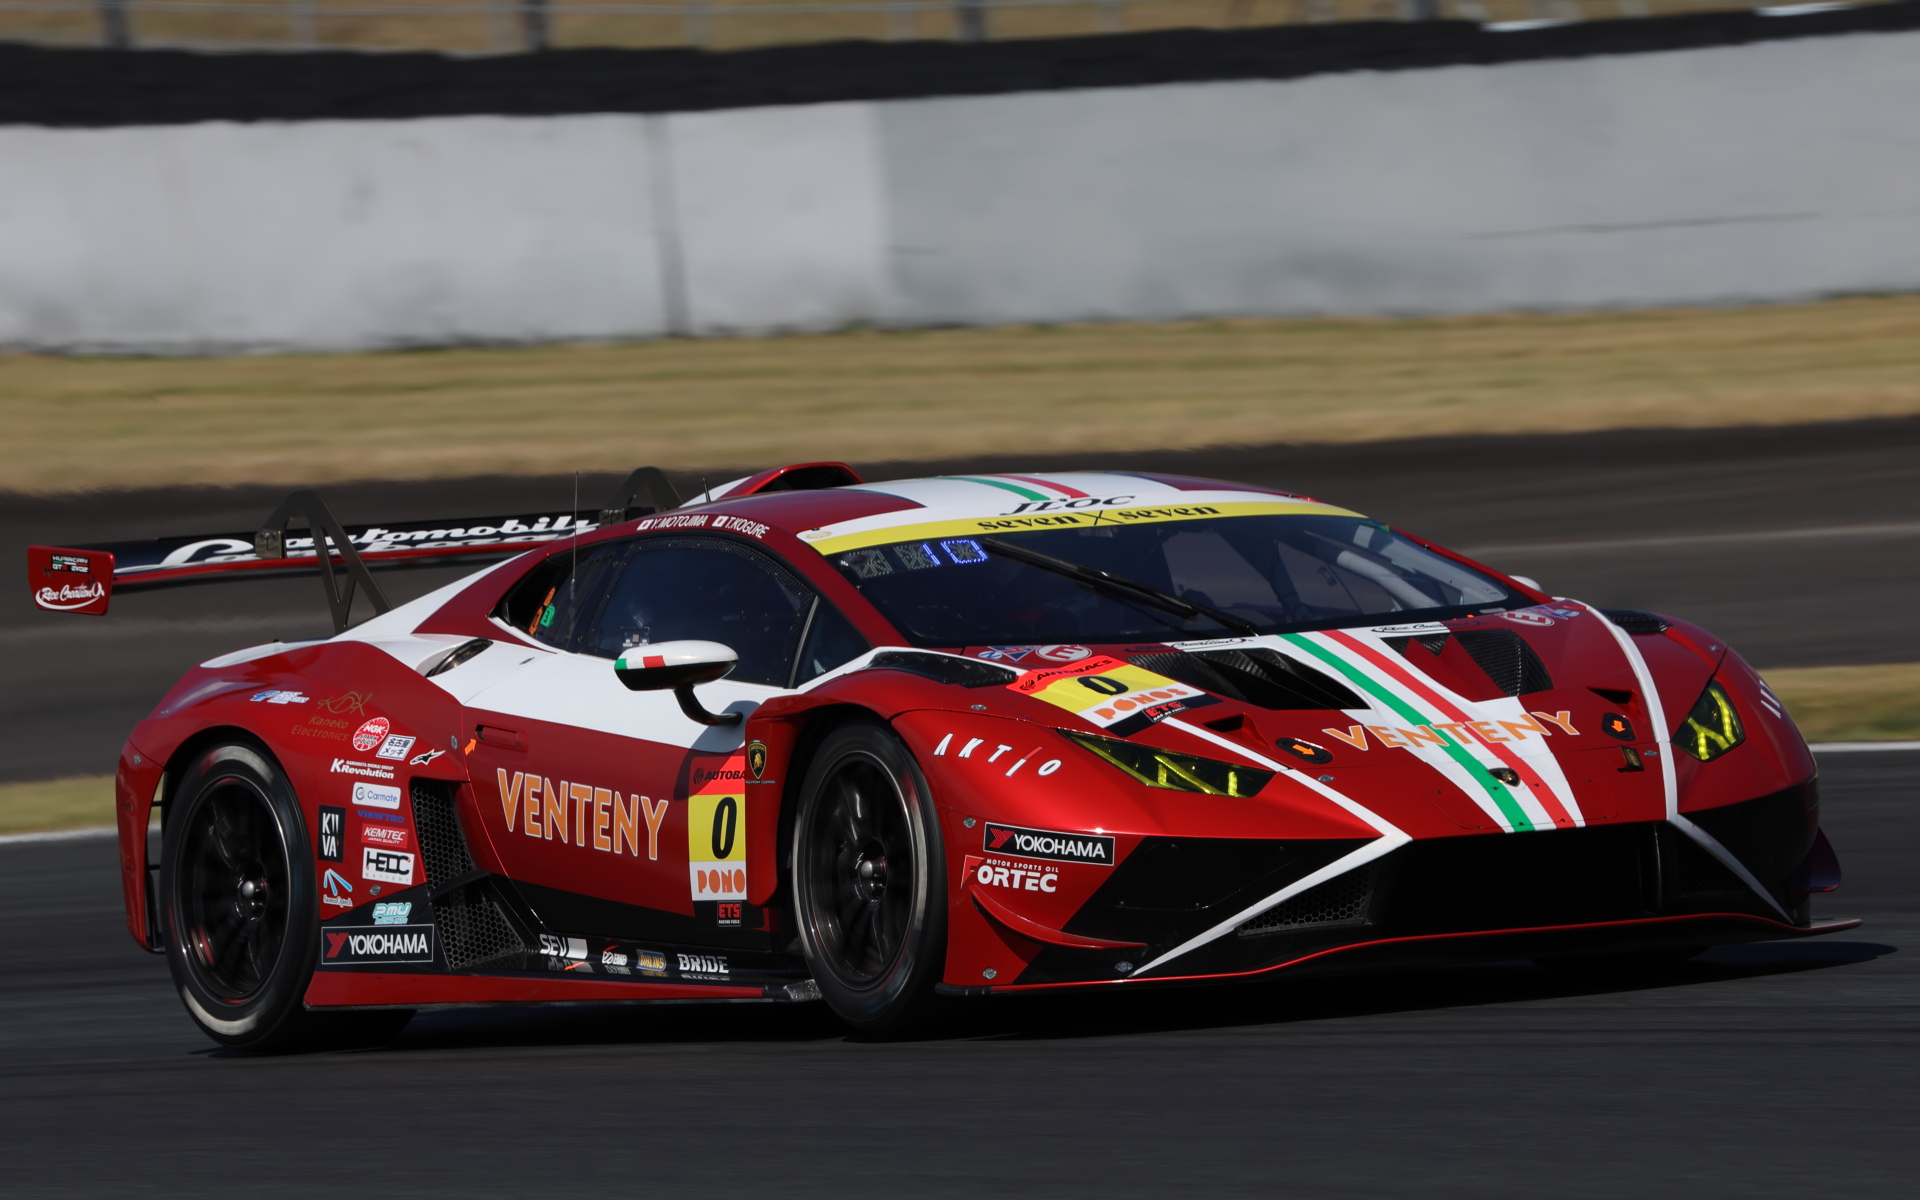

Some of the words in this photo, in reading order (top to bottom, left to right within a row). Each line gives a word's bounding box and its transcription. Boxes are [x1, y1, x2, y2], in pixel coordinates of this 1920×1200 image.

[978, 513, 1081, 532] seven
[1117, 505, 1201, 520] seven
[1077, 675, 1129, 696] 0
[1094, 688, 1189, 720] PONOS
[1145, 701, 1183, 717] ETS
[308, 715, 349, 729] Kaneko
[363, 724, 386, 734] NGK
[1321, 710, 1580, 751] VENTENY
[291, 725, 350, 741] Electronics
[367, 790, 398, 803] Carmate
[357, 810, 405, 823] VIEWTEC
[497, 767, 669, 861] VENTENY
[711, 796, 737, 859] 0
[1014, 833, 1106, 858] YOKOHAMA
[961, 855, 1058, 893] FORTEC
[986, 858, 1011, 868] MOTOR
[1013, 862, 1042, 871] SPORTS
[374, 904, 411, 918] PMU
[718, 903, 740, 918] ETS
[348, 934, 428, 955] YOKOHAMA
[677, 953, 729, 974] BRIDE
